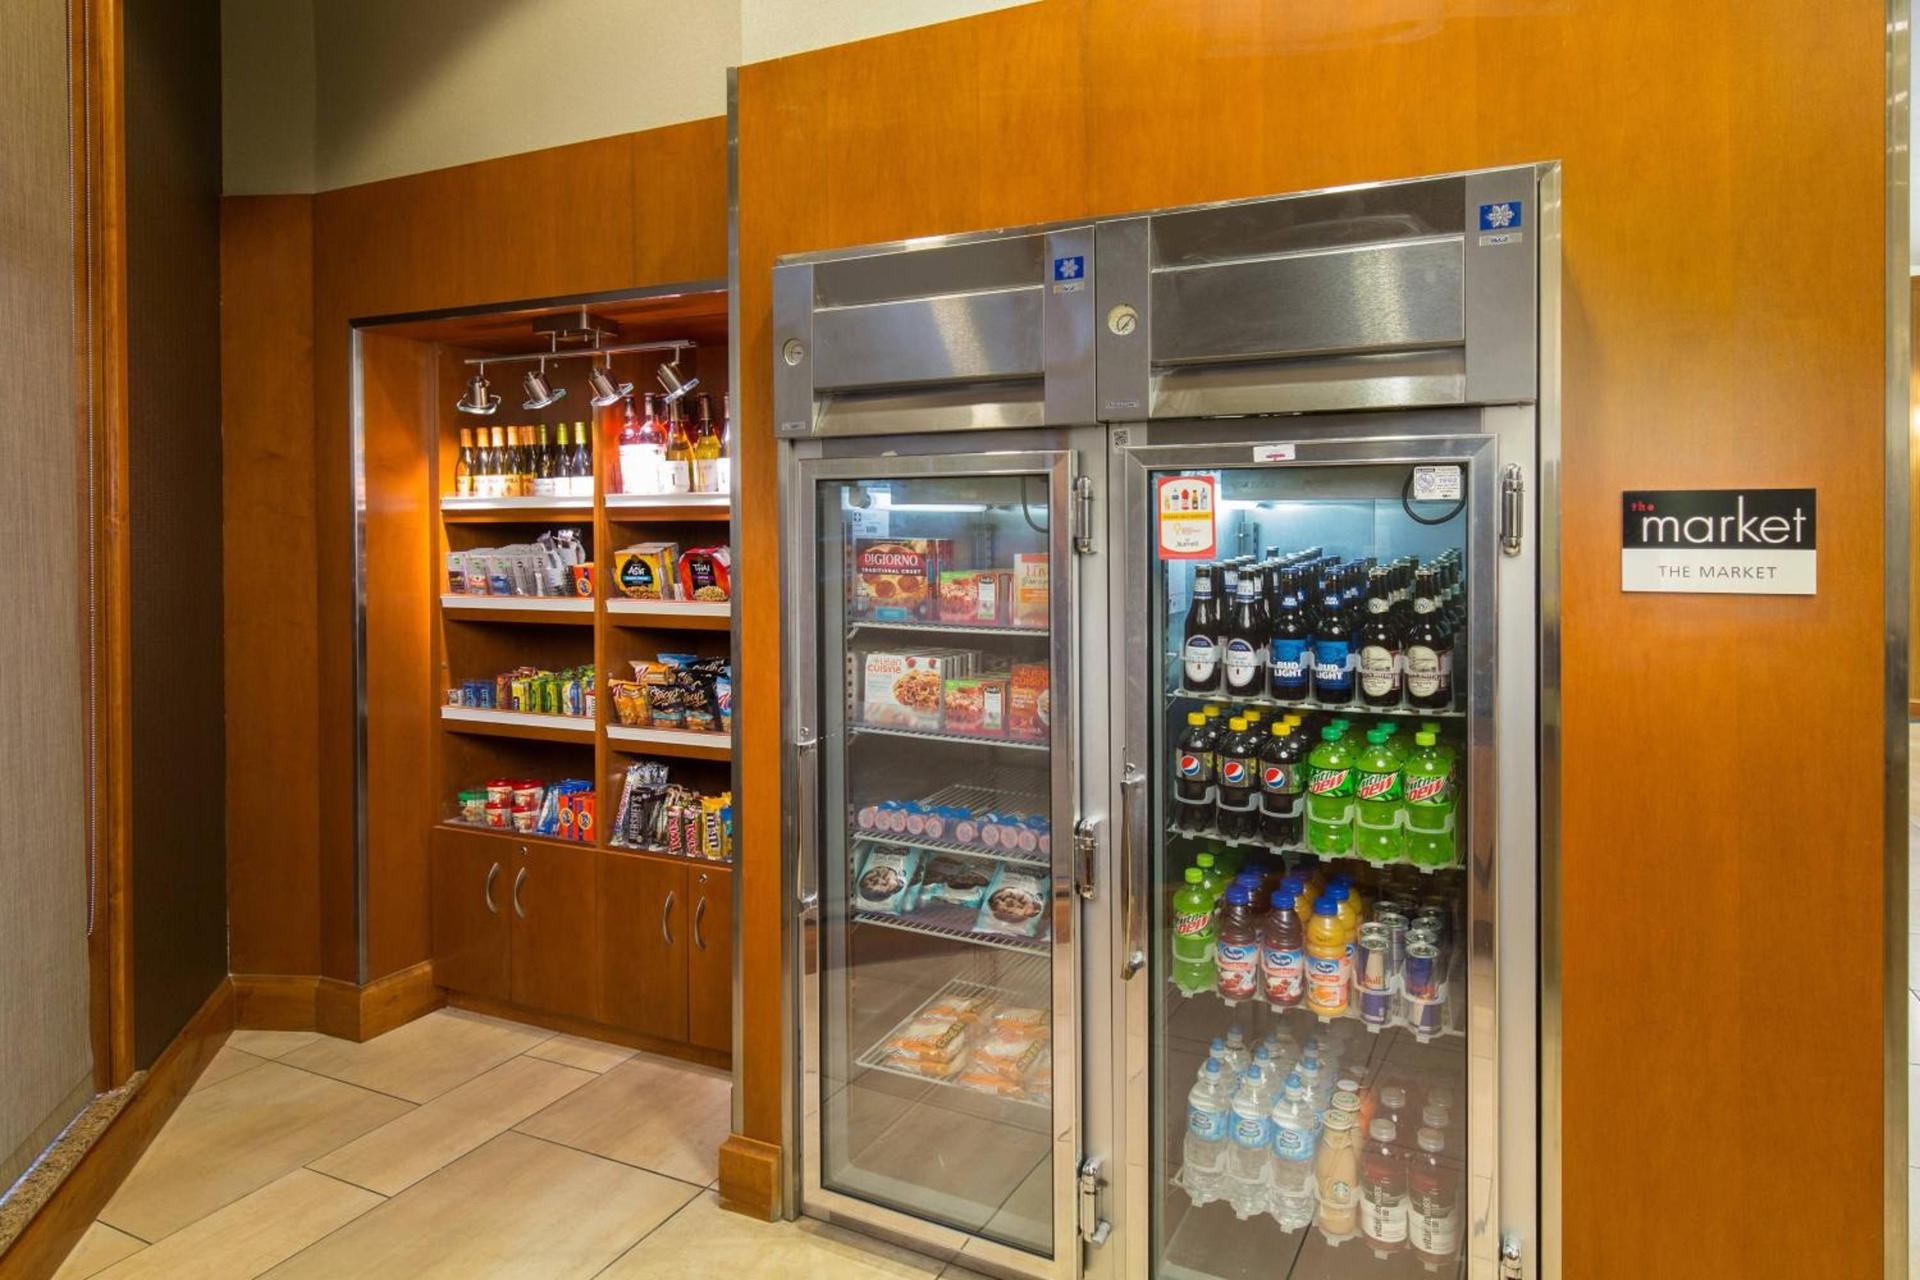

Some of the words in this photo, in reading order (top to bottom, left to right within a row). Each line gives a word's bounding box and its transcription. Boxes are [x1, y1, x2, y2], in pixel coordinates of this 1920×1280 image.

[1630, 500, 1656, 512] the
[1641, 494, 1807, 544] market
[1658, 565, 1691, 578] THE
[1699, 565, 1778, 580] MARKET
[1276, 661, 1299, 670] BUD
[1318, 663, 1339, 672] BUD
[1274, 669, 1303, 677] LIGHT
[1316, 671, 1344, 680] LIGHT
[629, 795, 642, 841] HERSHEY'S
